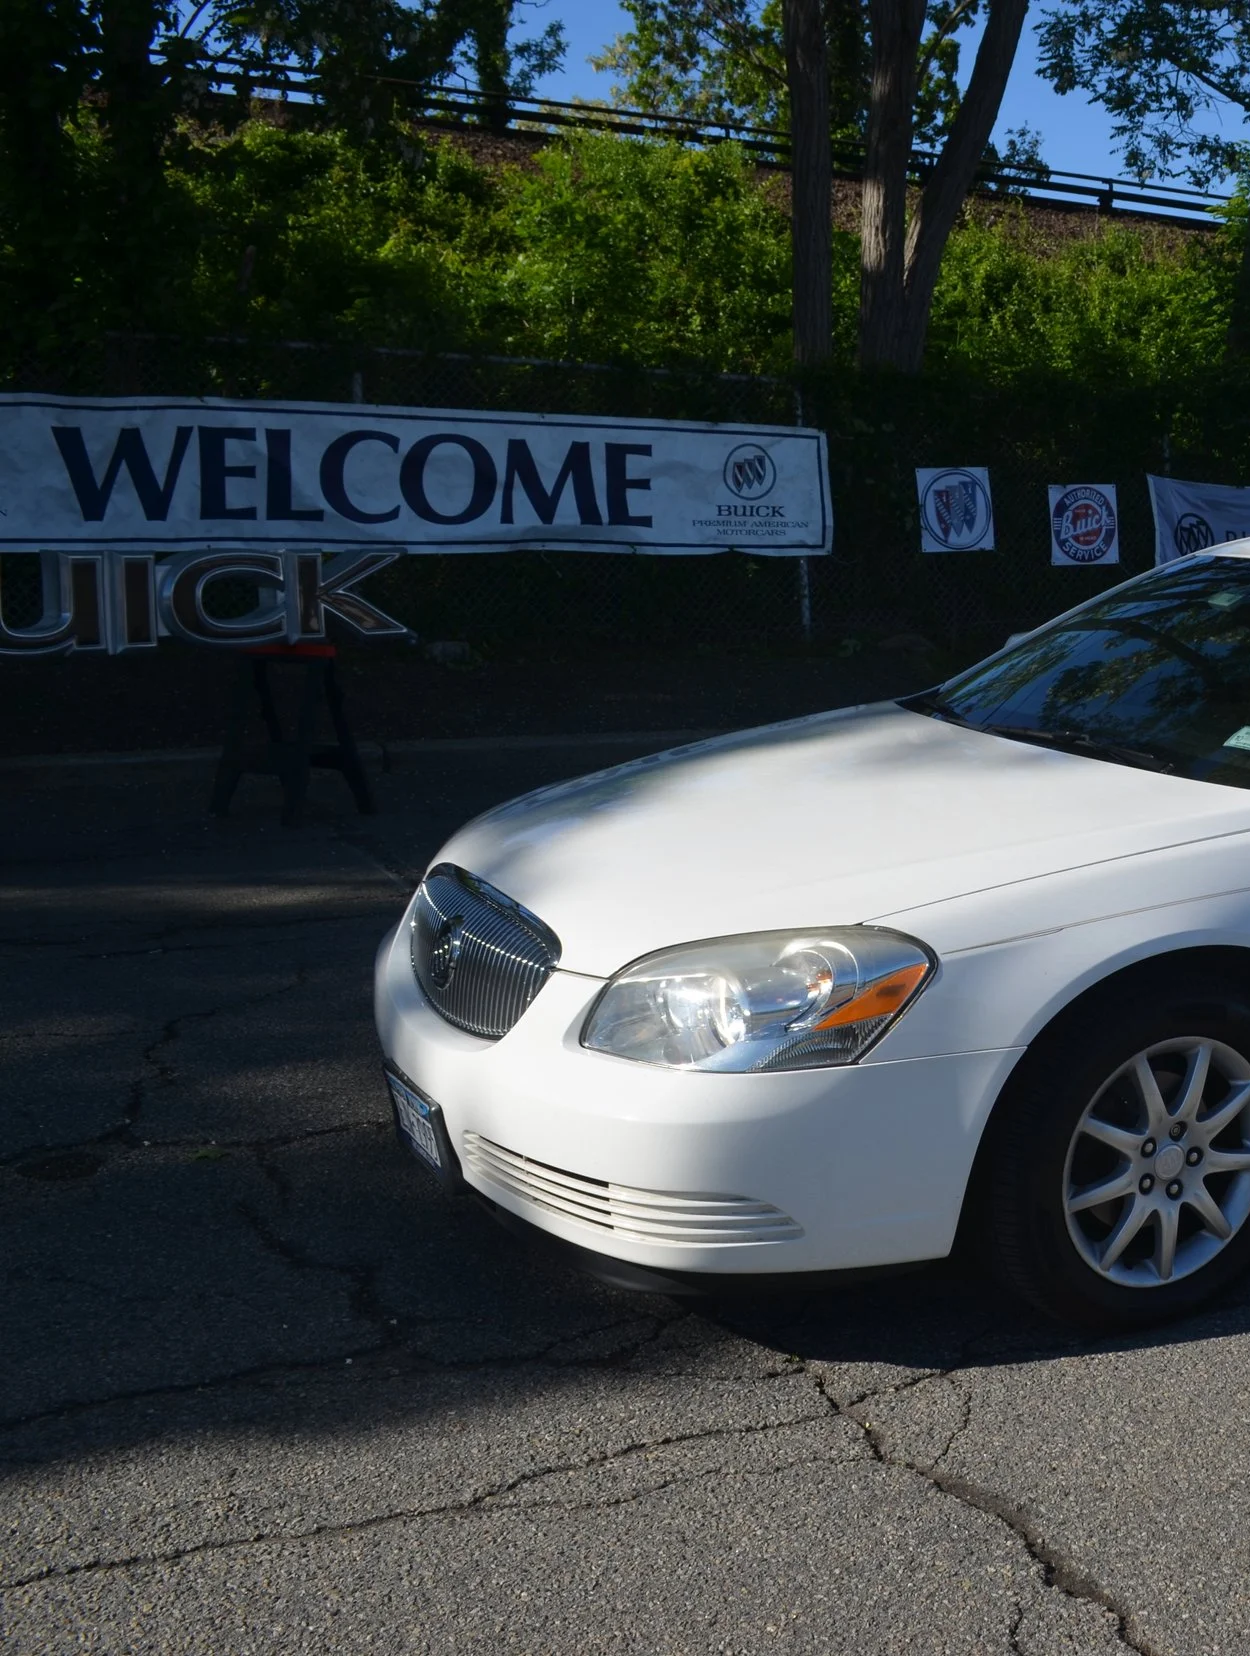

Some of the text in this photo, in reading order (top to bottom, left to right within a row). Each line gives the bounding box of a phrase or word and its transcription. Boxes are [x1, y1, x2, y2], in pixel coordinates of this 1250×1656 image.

[51, 424, 655, 529] WELCOME
[1063, 488, 1105, 508] AUTHORIZED
[716, 504, 786, 518] BUICK
[692, 519, 809, 529] PREMIUM AMERICAN
[716, 528, 787, 537] MOTORCARS
[1060, 504, 1110, 541] Buick
[1062, 541, 1107, 561] SERVICE
